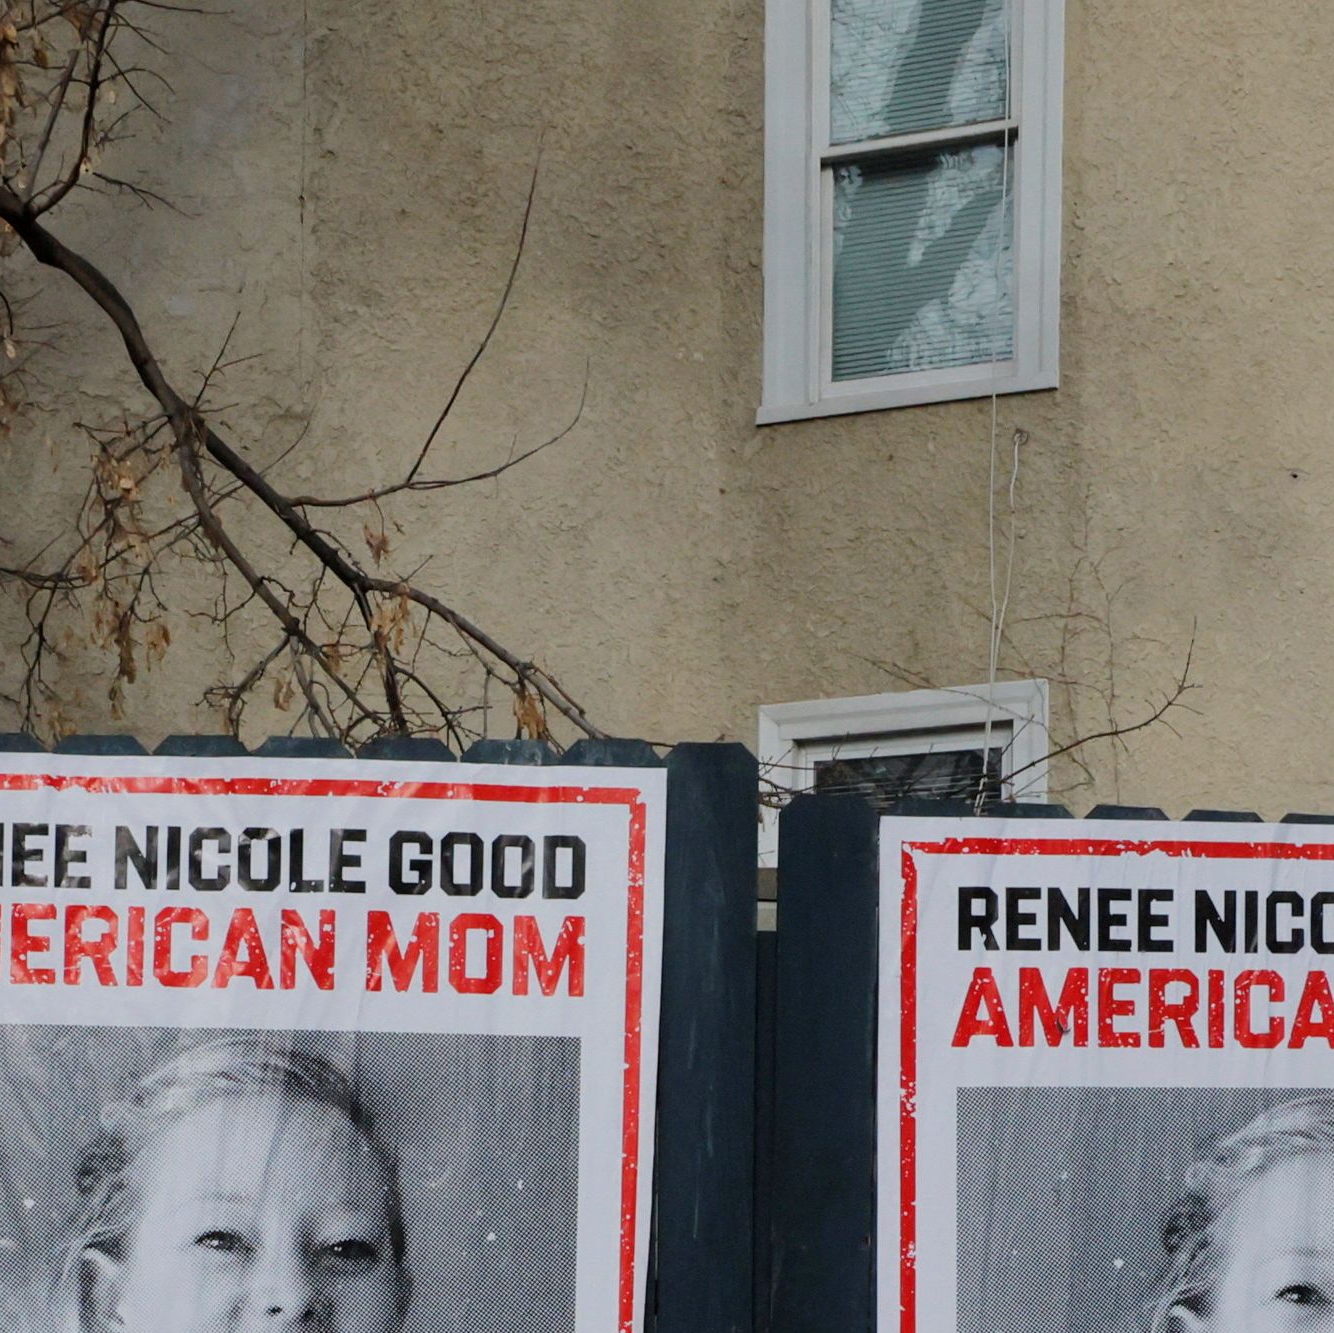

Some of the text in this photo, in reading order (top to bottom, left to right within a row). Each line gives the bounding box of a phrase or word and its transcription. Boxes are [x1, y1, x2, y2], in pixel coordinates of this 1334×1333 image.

[114, 825, 367, 894] NICOLE
[388, 830, 587, 900] GOOD
[367, 911, 586, 998] MOM
[958, 886, 1175, 952] RENEE
